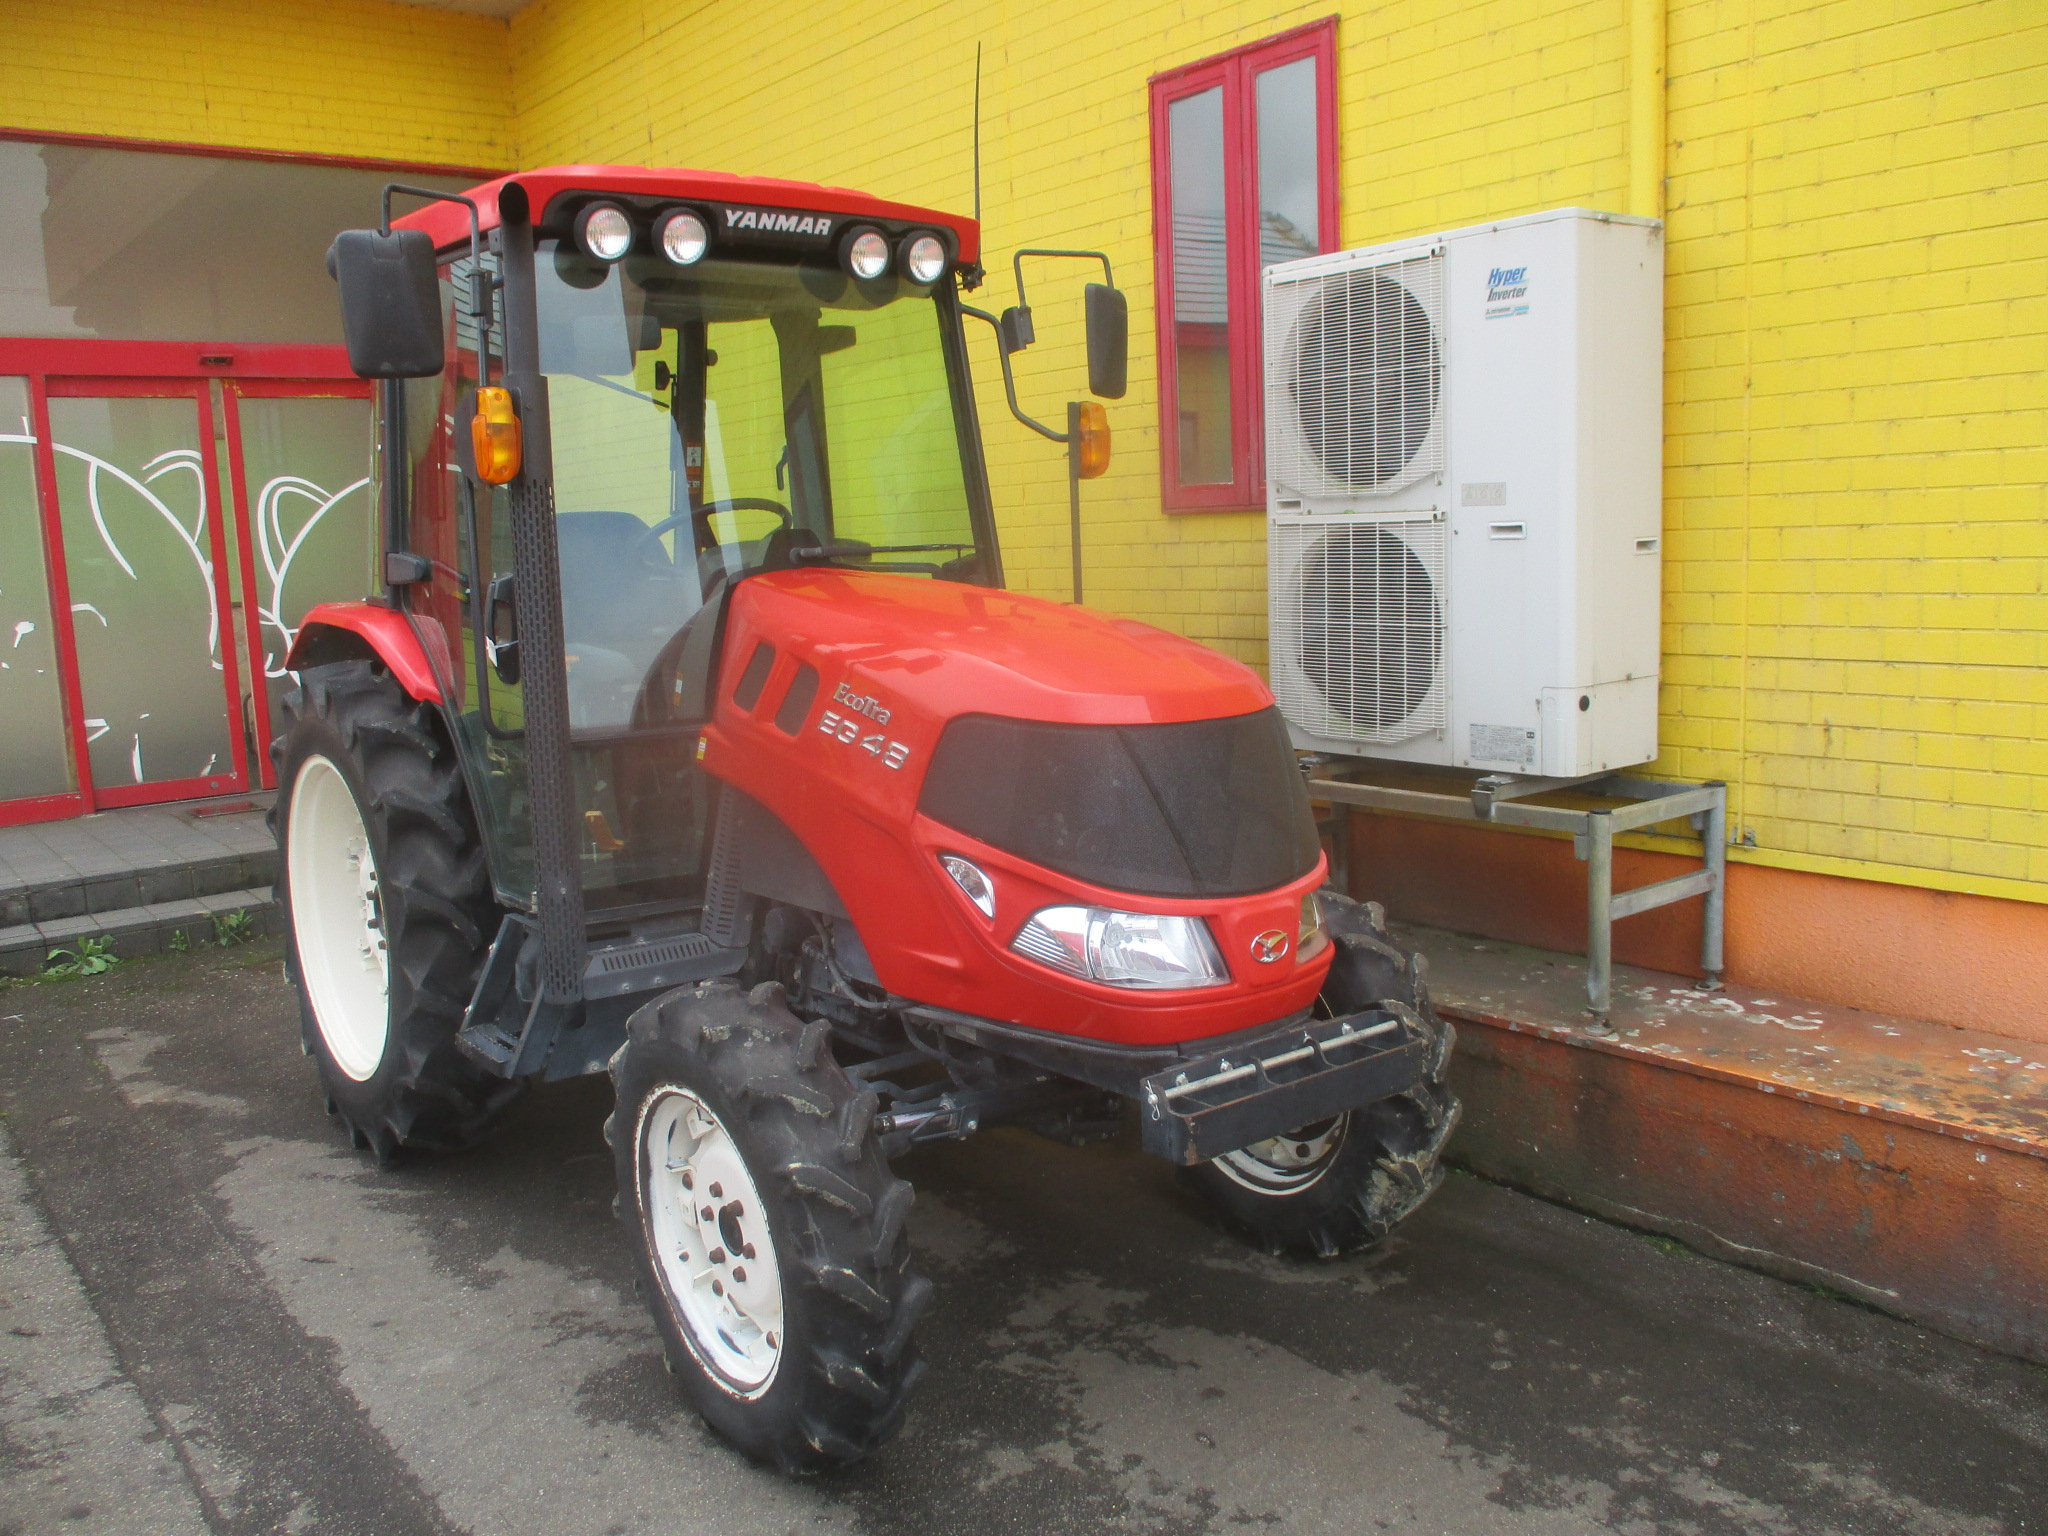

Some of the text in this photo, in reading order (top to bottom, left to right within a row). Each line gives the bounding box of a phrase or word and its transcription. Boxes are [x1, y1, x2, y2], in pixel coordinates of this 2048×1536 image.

[725, 209, 832, 236] YANMAR
[1488, 267, 1528, 288] Hyper
[1487, 287, 1528, 302] Inverter
[833, 682, 891, 726] EcoTra
